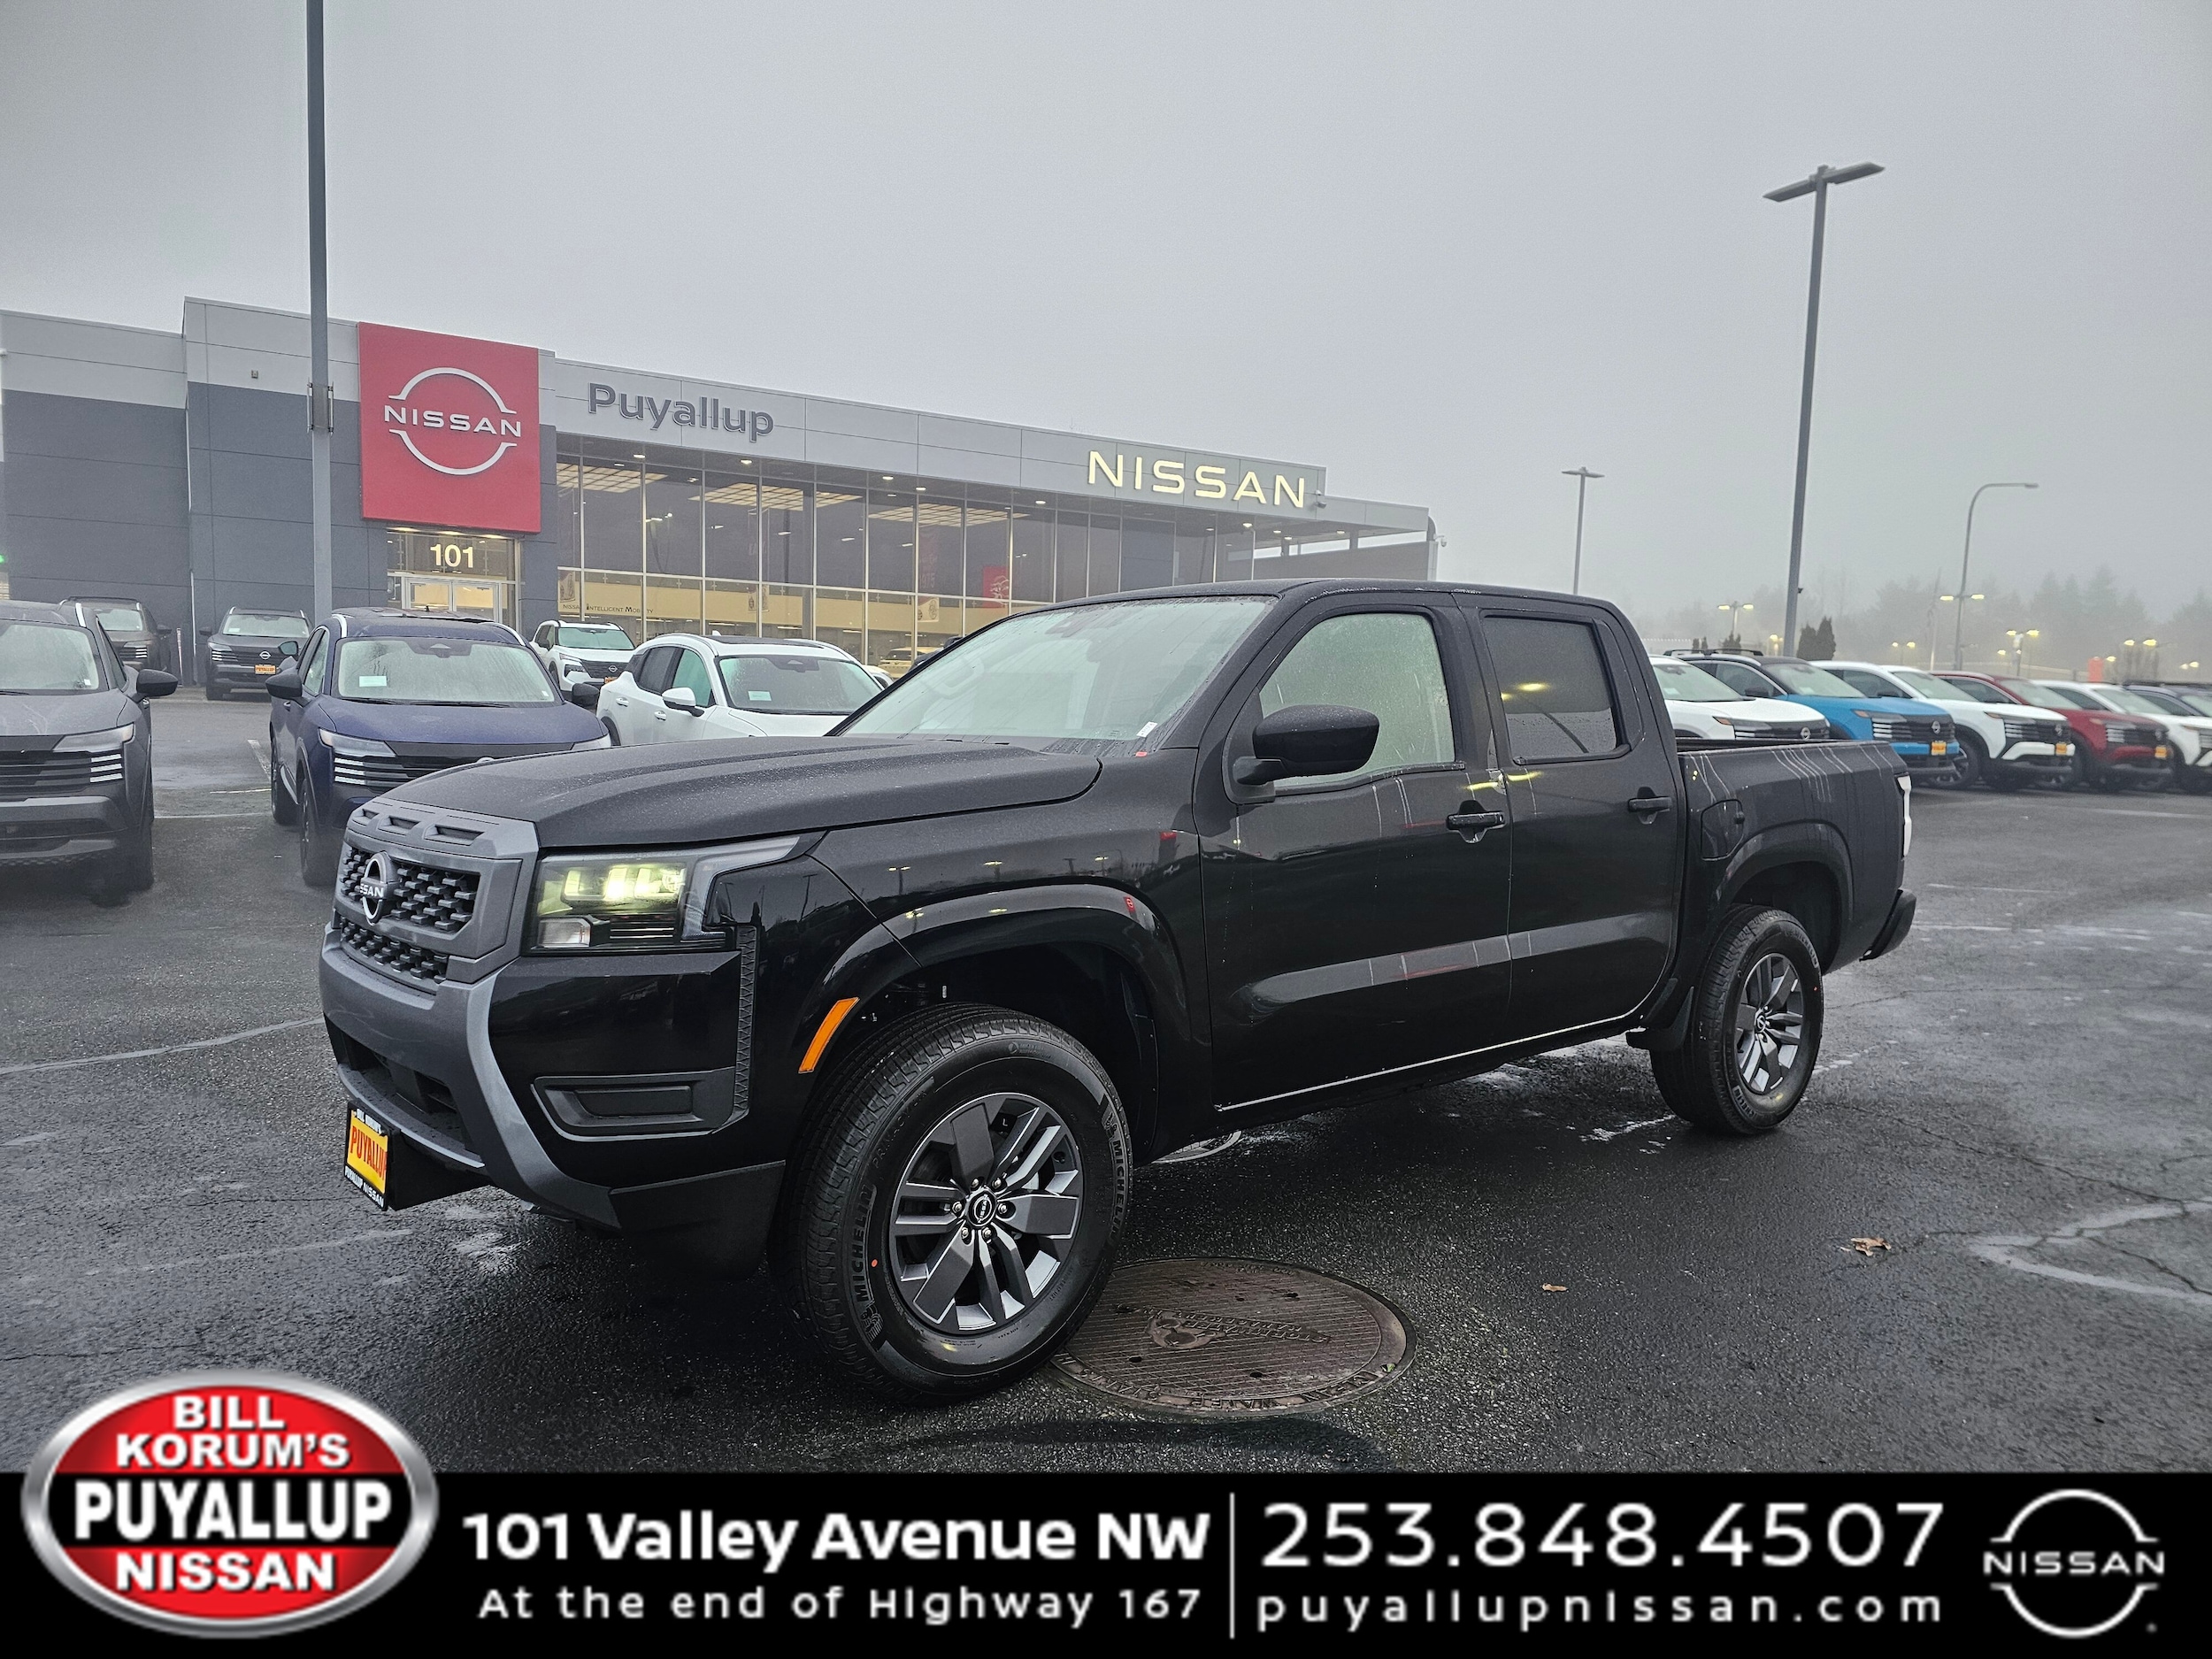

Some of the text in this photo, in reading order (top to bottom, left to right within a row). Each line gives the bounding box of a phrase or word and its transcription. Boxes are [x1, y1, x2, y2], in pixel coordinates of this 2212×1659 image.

[384, 404, 521, 438] NISSAN
[588, 382, 774, 442] Puyallup
[1088, 450, 1305, 509] NISSAN
[430, 543, 473, 568] 101
[586, 603, 624, 612] INTELLIGENT
[363, 1181, 385, 1208] NISSAN
[1110, 1140, 1125, 1236] MICHELIN
[851, 1183, 875, 1304] MICHELIN
